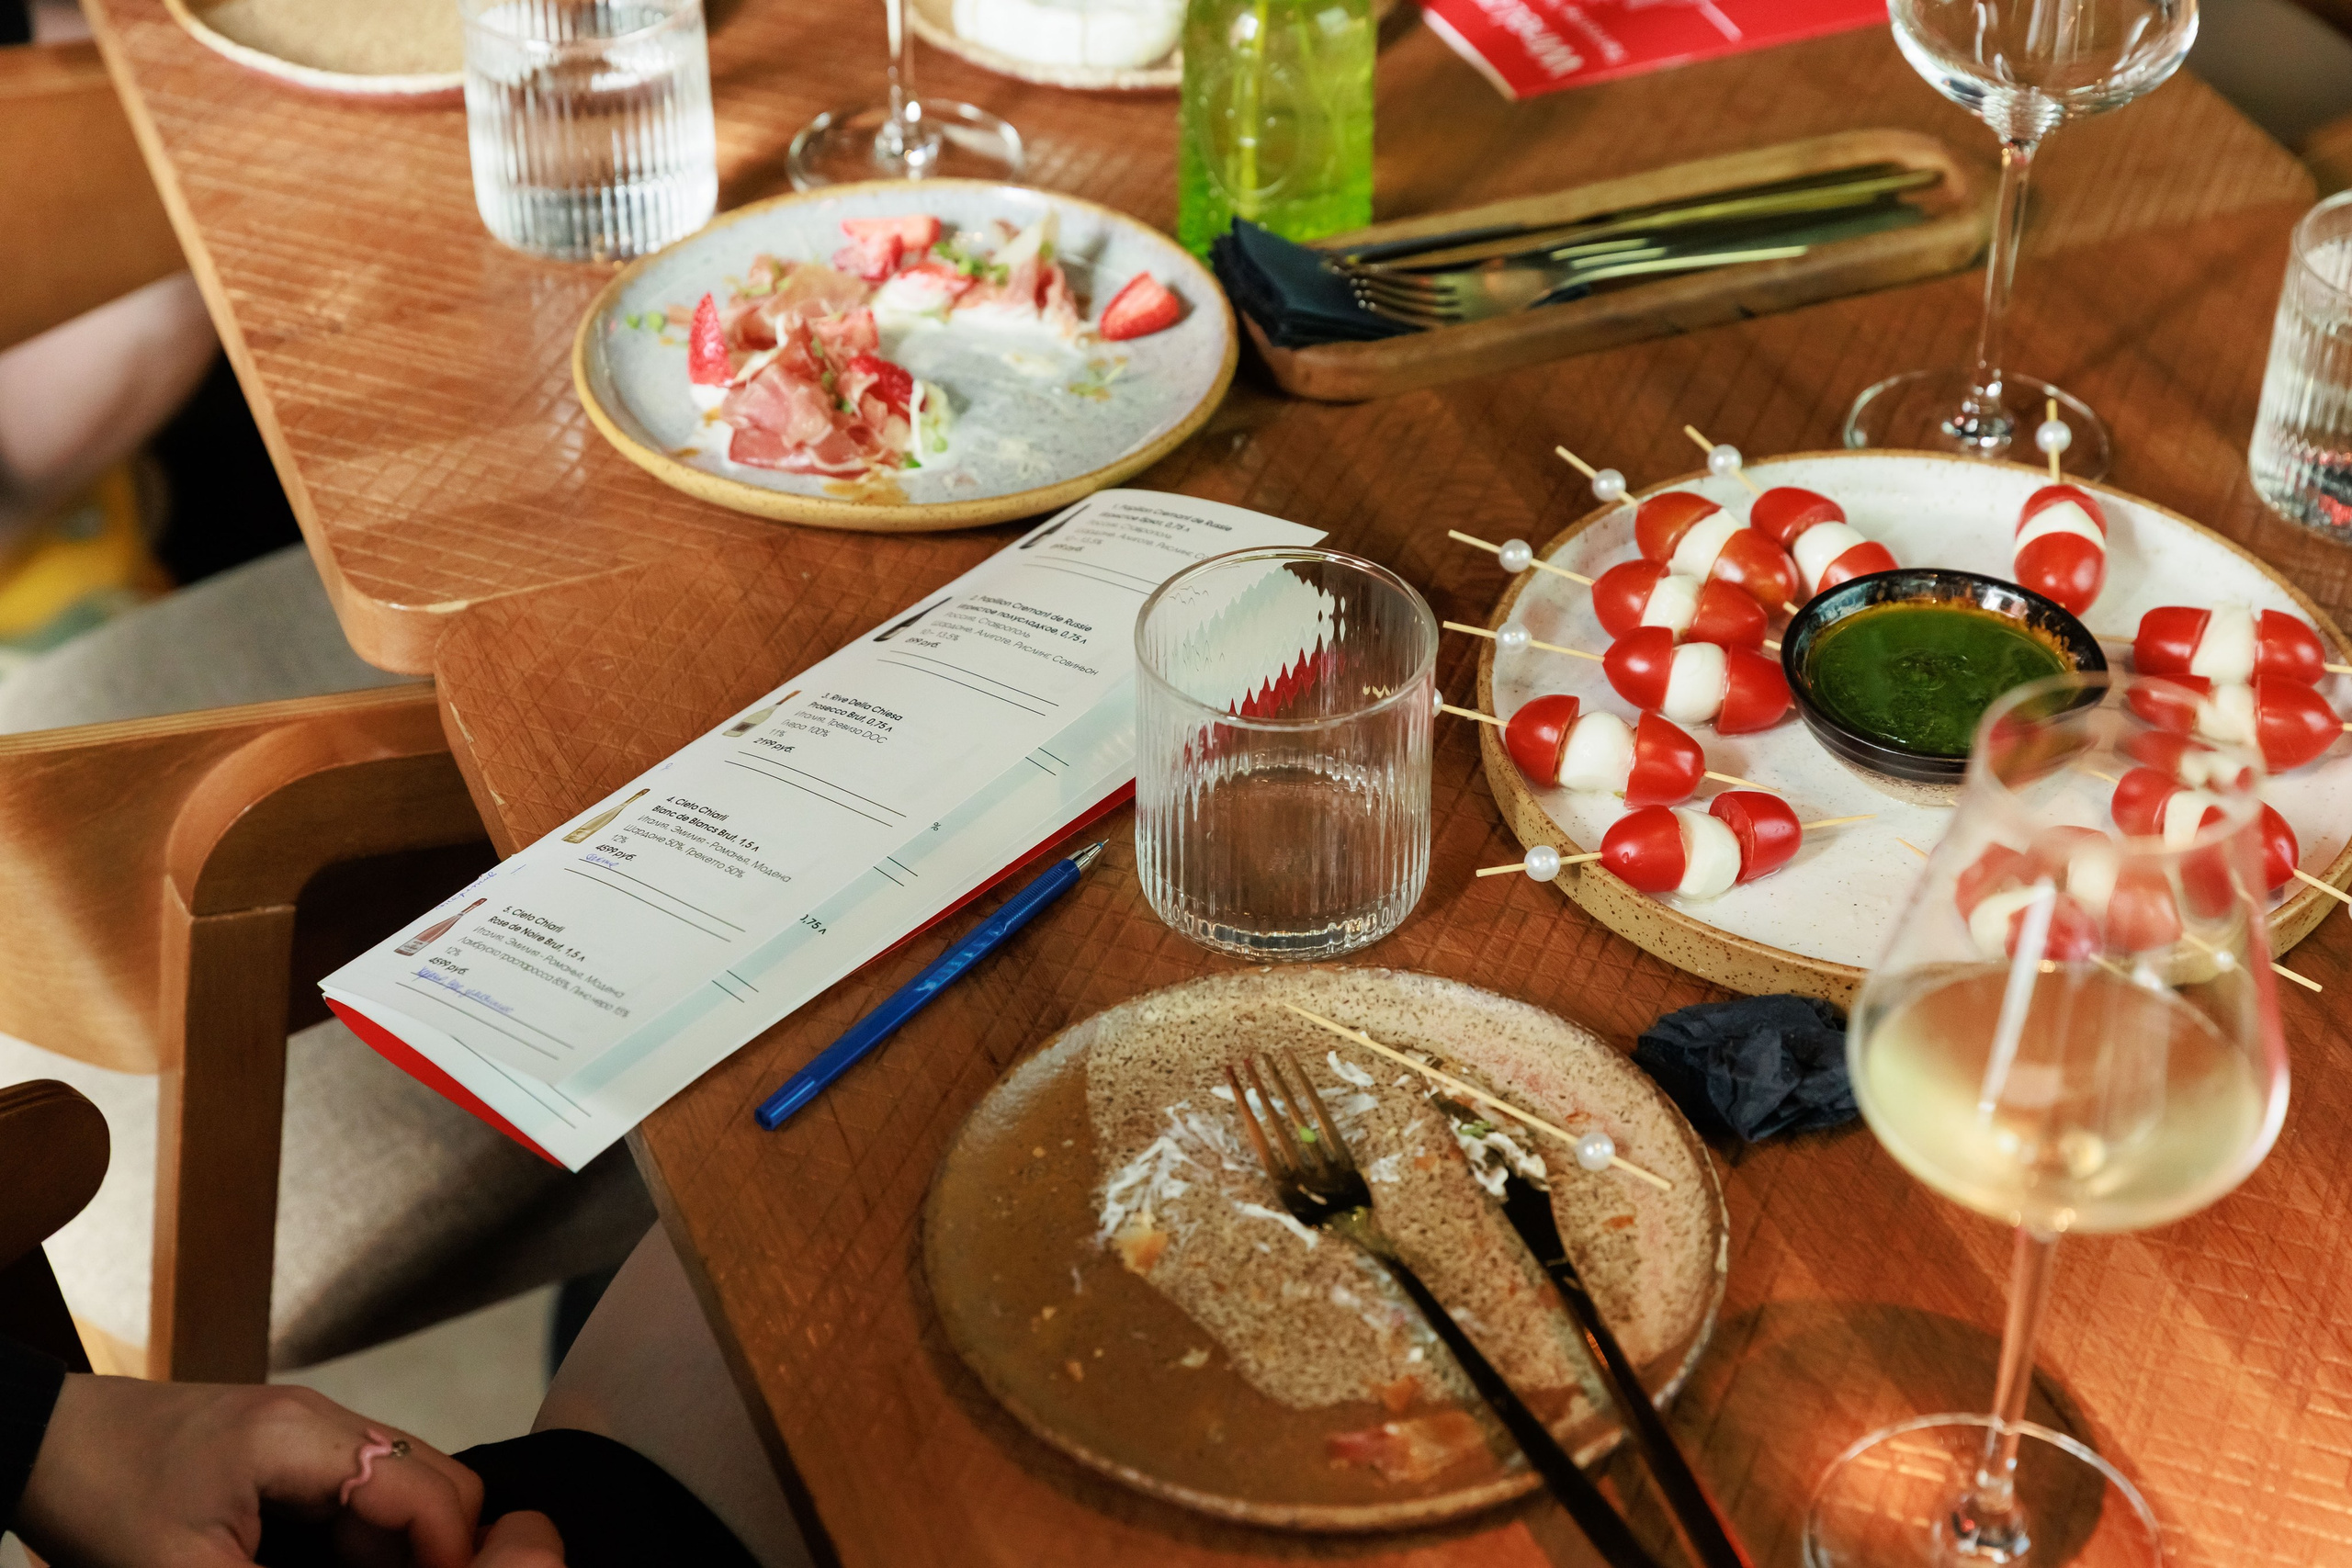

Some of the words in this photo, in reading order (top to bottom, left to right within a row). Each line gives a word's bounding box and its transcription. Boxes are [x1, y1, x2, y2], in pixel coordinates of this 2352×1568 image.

[1064, 618, 1092, 632] Russie
[1060, 631, 1082, 641] 0,75
[1052, 656, 1099, 675] Совиньон
[808, 702, 848, 716] Prosecco
[846, 711, 866, 723] Brut,
[866, 718, 888, 729] 0,75
[830, 694, 849, 703] Rive
[848, 699, 872, 710] Della
[871, 706, 903, 721] Chiesa
[769, 728, 786, 738] 11%
[808, 727, 831, 738] 100%
[828, 718, 863, 735] Тревизо
[862, 730, 888, 744] DOC
[675, 799, 699, 810] Cleto
[698, 807, 729, 821] Chiarli
[652, 806, 677, 818] Blanc
[688, 818, 718, 833] Blancs
[717, 829, 738, 842] Brut,
[740, 839, 754, 848] 1,5
[595, 844, 618, 853] 4599
[611, 834, 629, 844] 12%
[623, 824, 666, 842] Шардоне
[665, 839, 685, 852] 50%,
[684, 847, 726, 869] Грекетто
[724, 865, 746, 878] 50%
[671, 826, 707, 843] Эмилия
[709, 841, 751, 865] Романья,
[751, 861, 792, 883] Модена
[512, 909, 536, 921] Cleto
[535, 918, 565, 933] Chiarli
[488, 916, 510, 927] Rose
[520, 928, 545, 942] Noire
[544, 938, 564, 952] Brut,
[566, 948, 581, 958] 1,5
[445, 946, 462, 956] 12%
[428, 957, 452, 967] 4599
